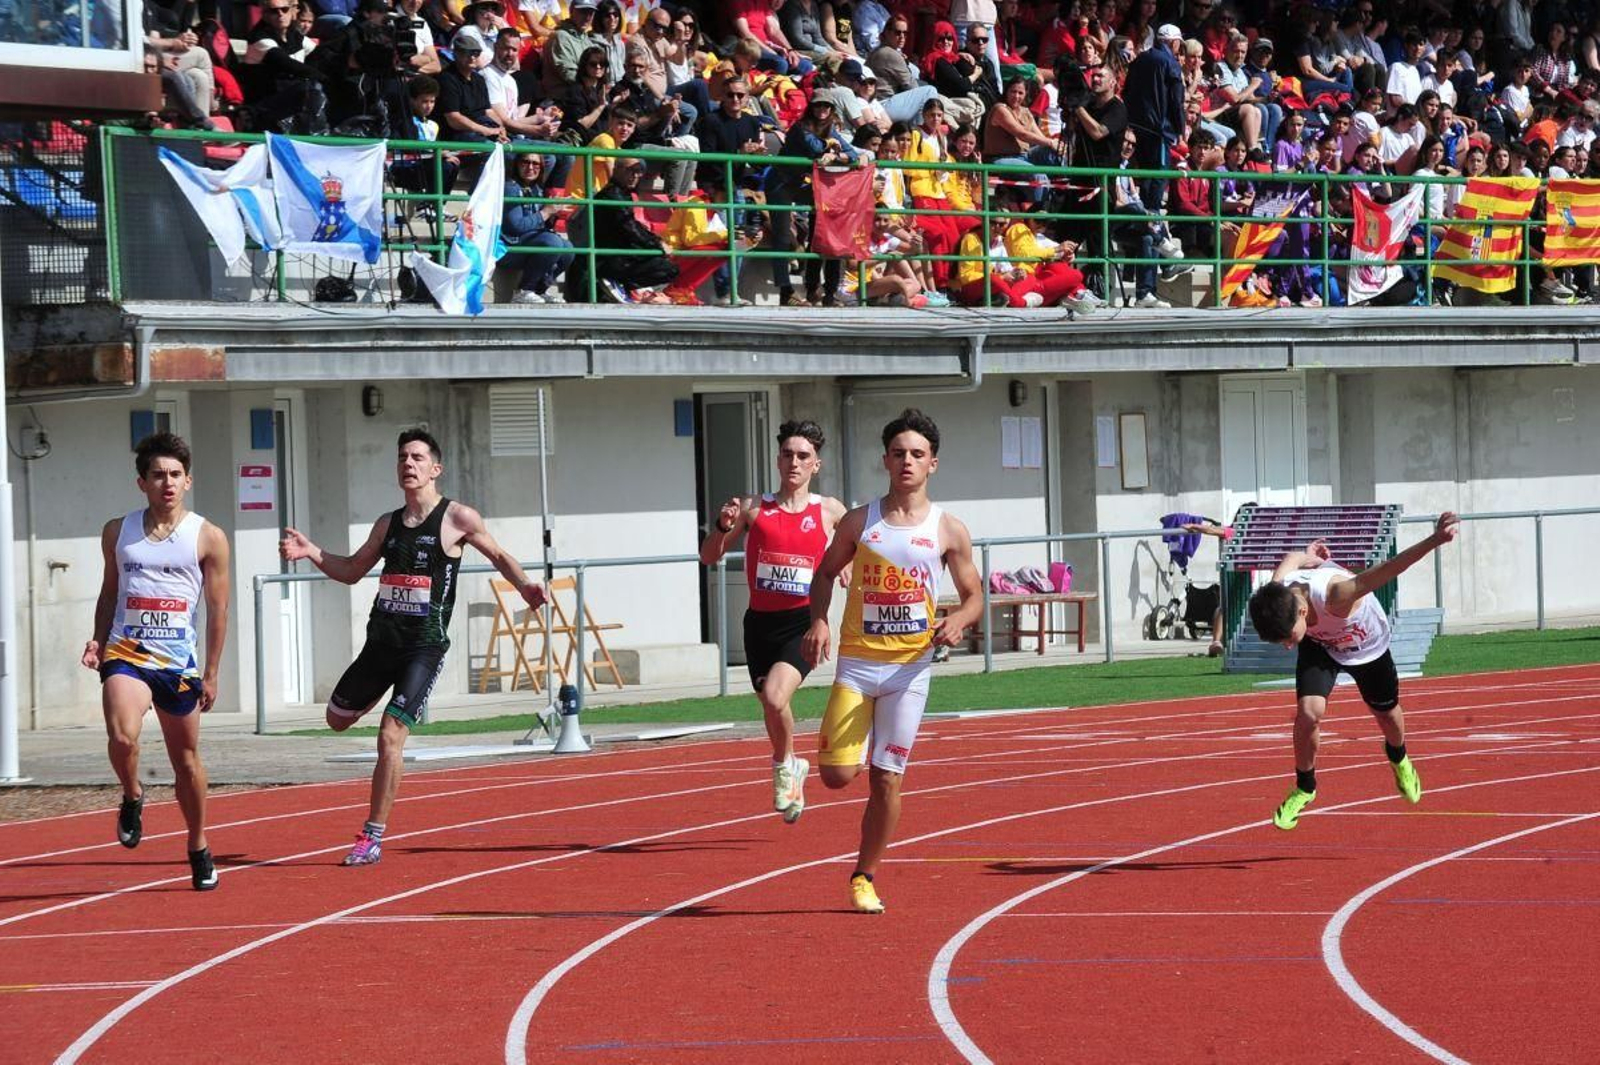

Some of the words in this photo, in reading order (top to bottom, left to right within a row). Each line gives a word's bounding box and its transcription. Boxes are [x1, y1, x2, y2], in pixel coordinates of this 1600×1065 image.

[771, 566, 798, 581] NAV
[391, 586, 413, 602] EXT
[140, 611, 169, 627] CNR
[878, 605, 912, 621] MUR
